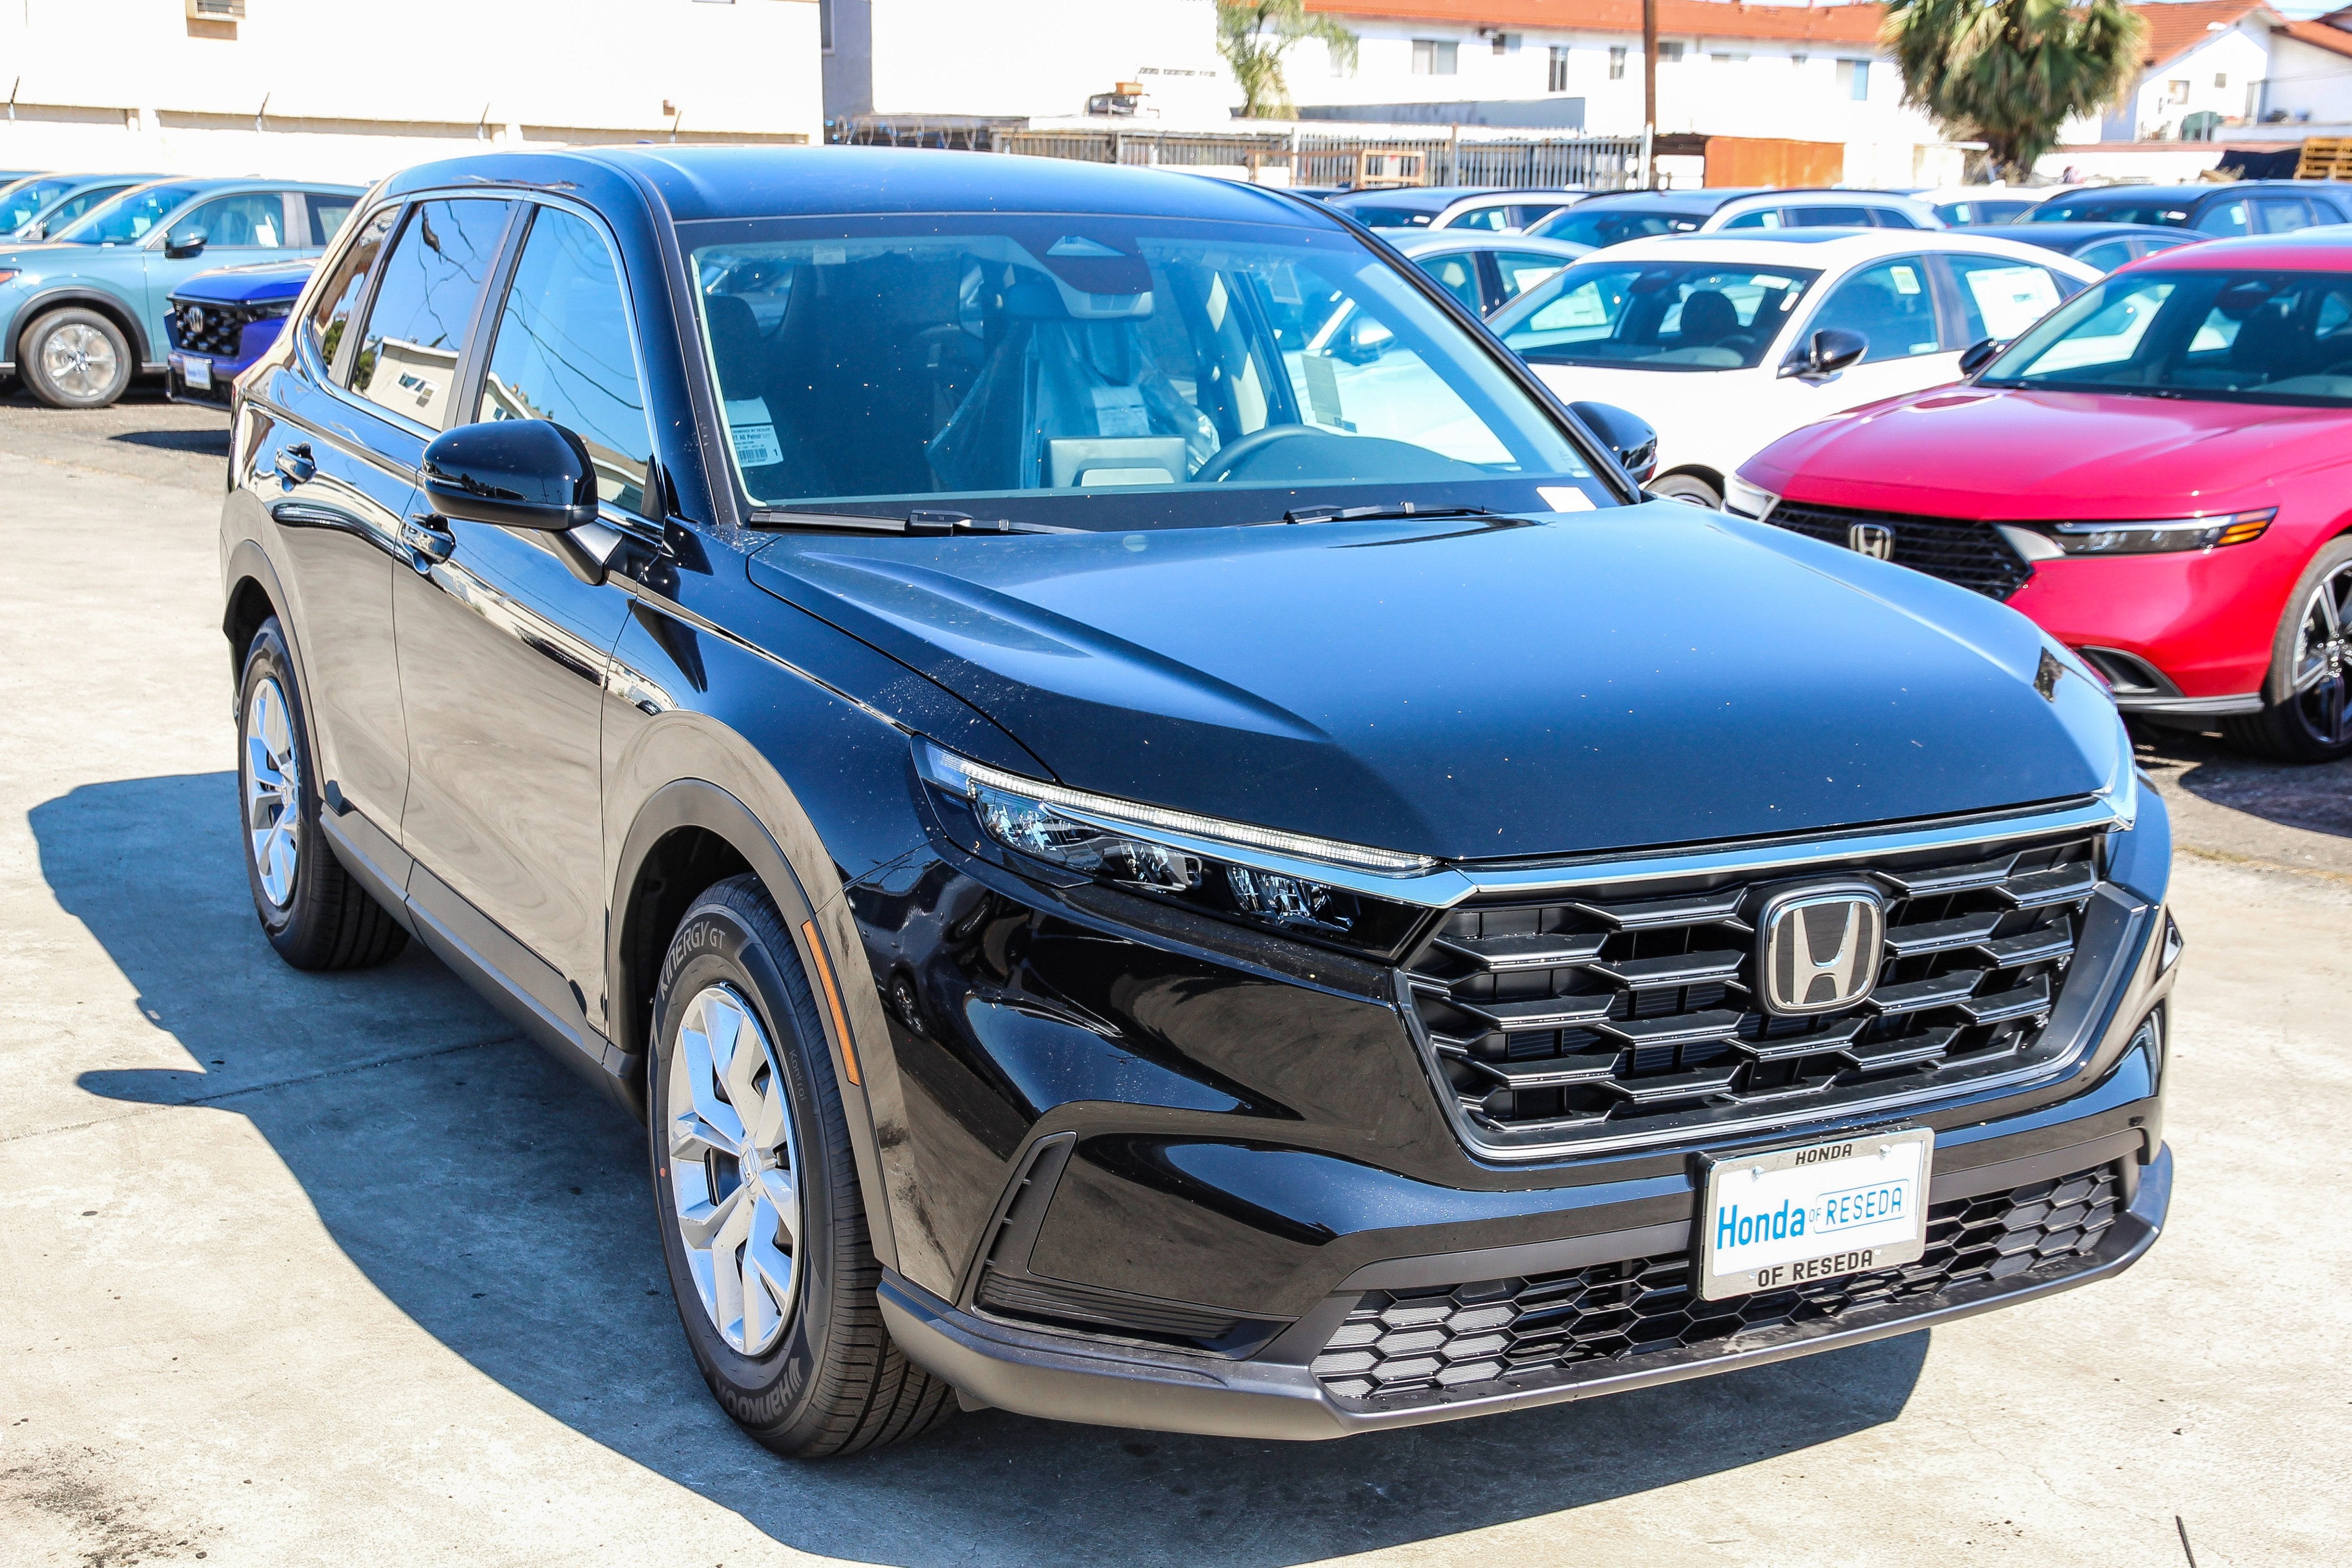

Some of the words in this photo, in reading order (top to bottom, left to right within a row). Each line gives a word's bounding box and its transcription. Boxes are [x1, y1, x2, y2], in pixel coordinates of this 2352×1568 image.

[709, 928, 726, 949] GT
[789, 1049, 807, 1101] Kontrol
[1795, 1143, 1853, 1166] HONDA
[1716, 1199, 1805, 1250] Honda
[1809, 1209, 1821, 1223] OF
[1826, 1187, 1902, 1226] RESEDA
[1757, 1266, 1784, 1288] OF
[1792, 1249, 1874, 1281] RESEDA
